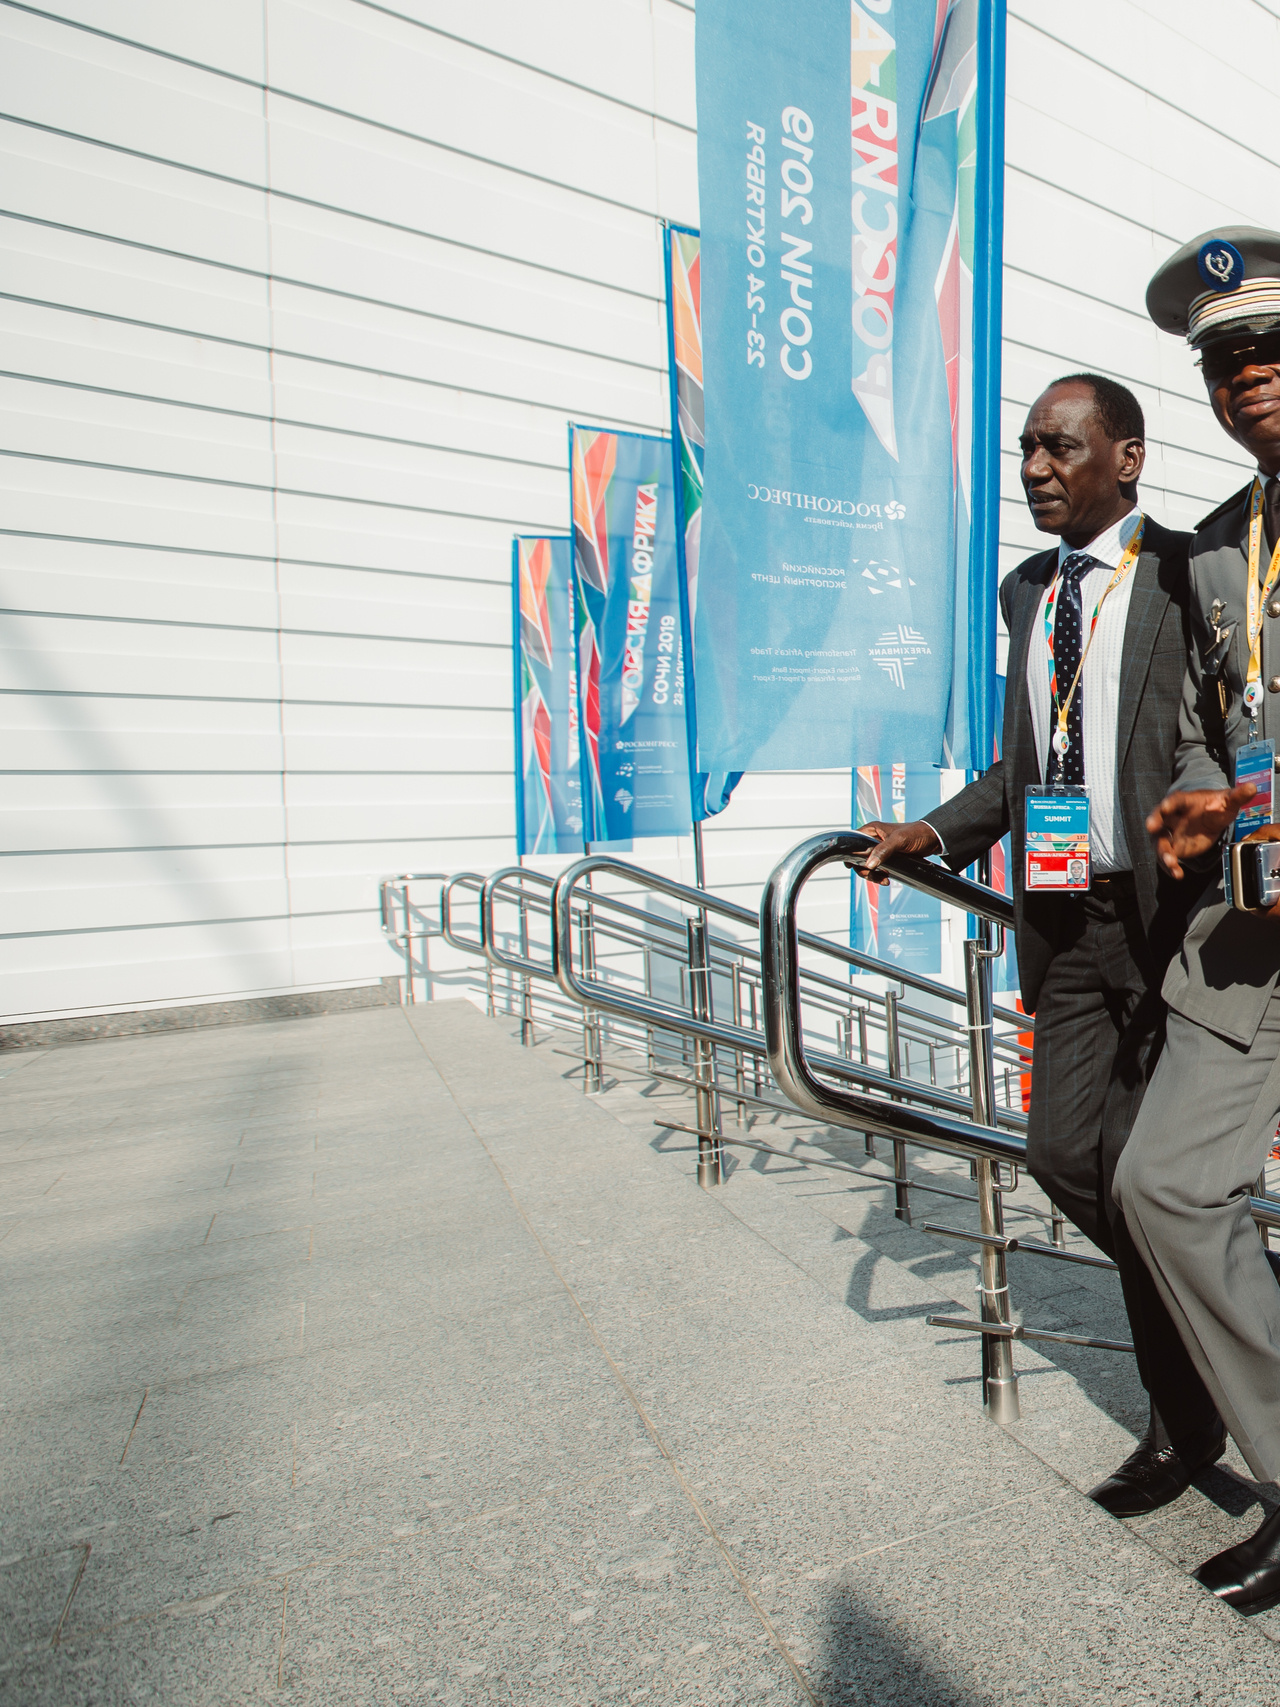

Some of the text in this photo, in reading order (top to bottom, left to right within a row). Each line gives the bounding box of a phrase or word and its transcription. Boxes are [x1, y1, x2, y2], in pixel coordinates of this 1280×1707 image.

[621, 483, 659, 705] РОССИЯ-АФРИКА
[653, 615, 676, 705] СОЧИ 2019
